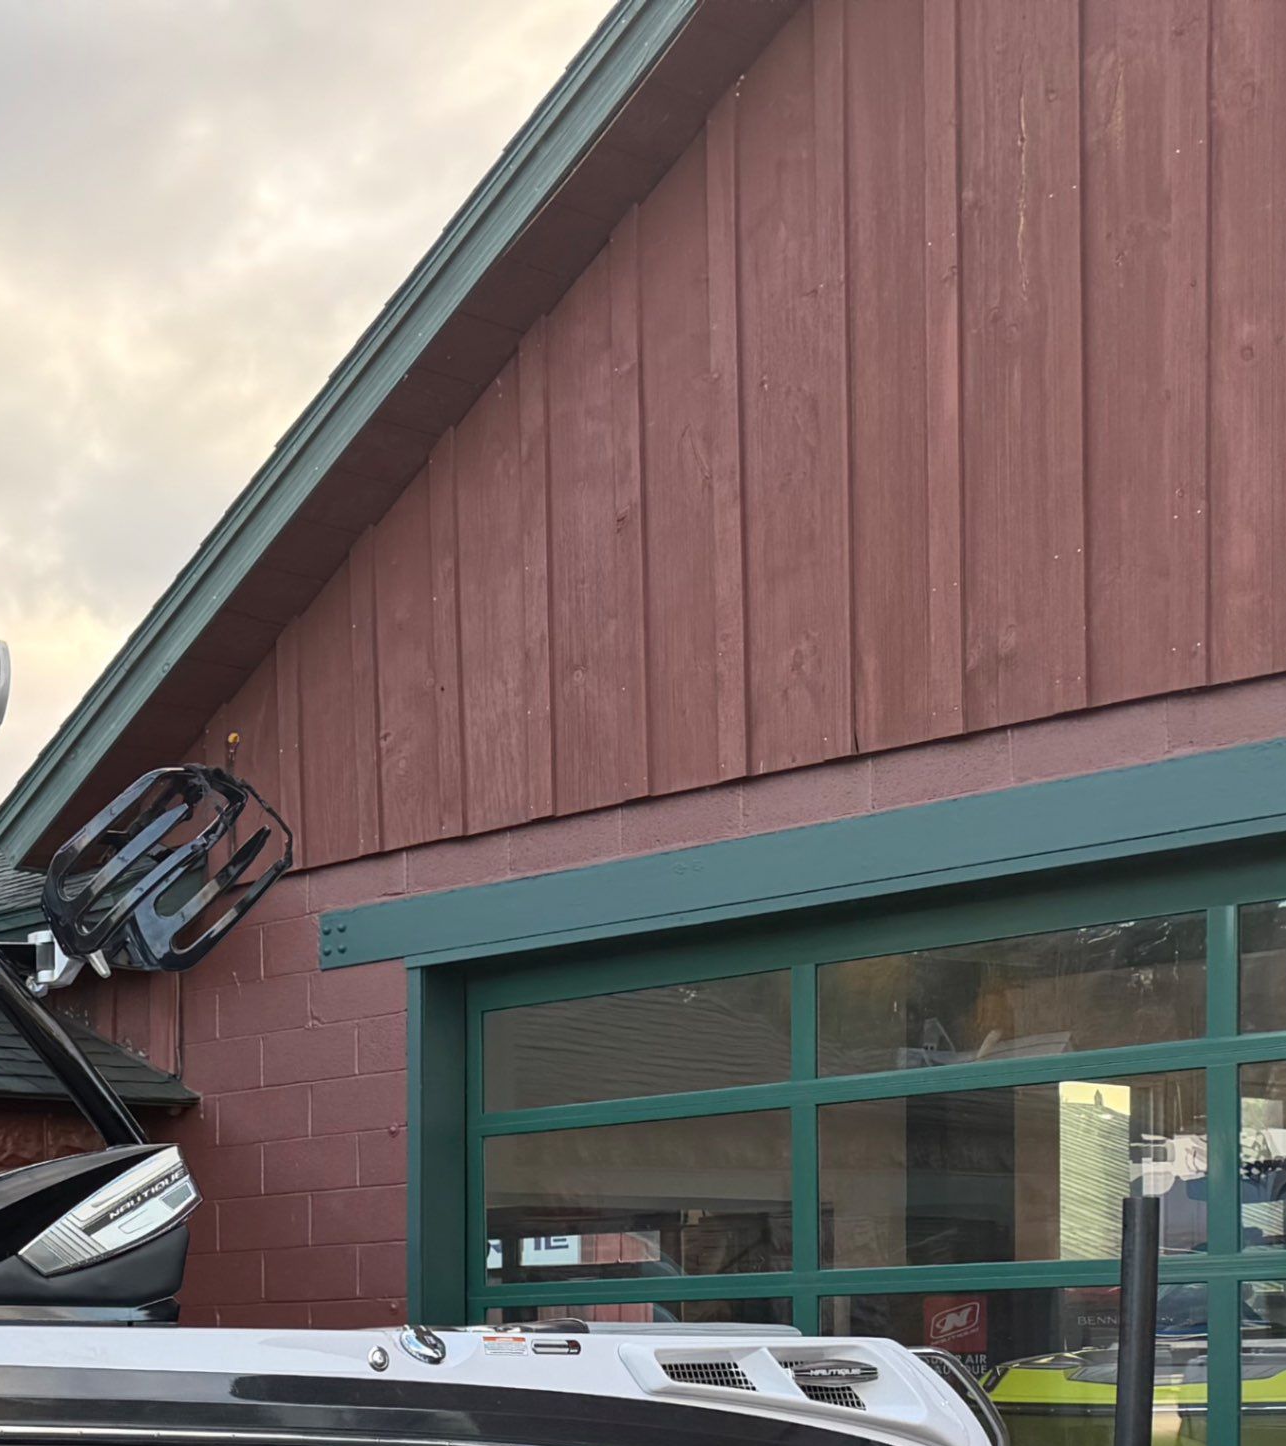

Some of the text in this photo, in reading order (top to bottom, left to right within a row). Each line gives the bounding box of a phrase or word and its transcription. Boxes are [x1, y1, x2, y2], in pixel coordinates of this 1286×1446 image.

[109, 1168, 185, 1220] NAUTIQUE
[1077, 1315, 1119, 1326] BENN
[965, 1354, 987, 1365] AIR
[809, 1368, 861, 1377] NAUTIQUE
